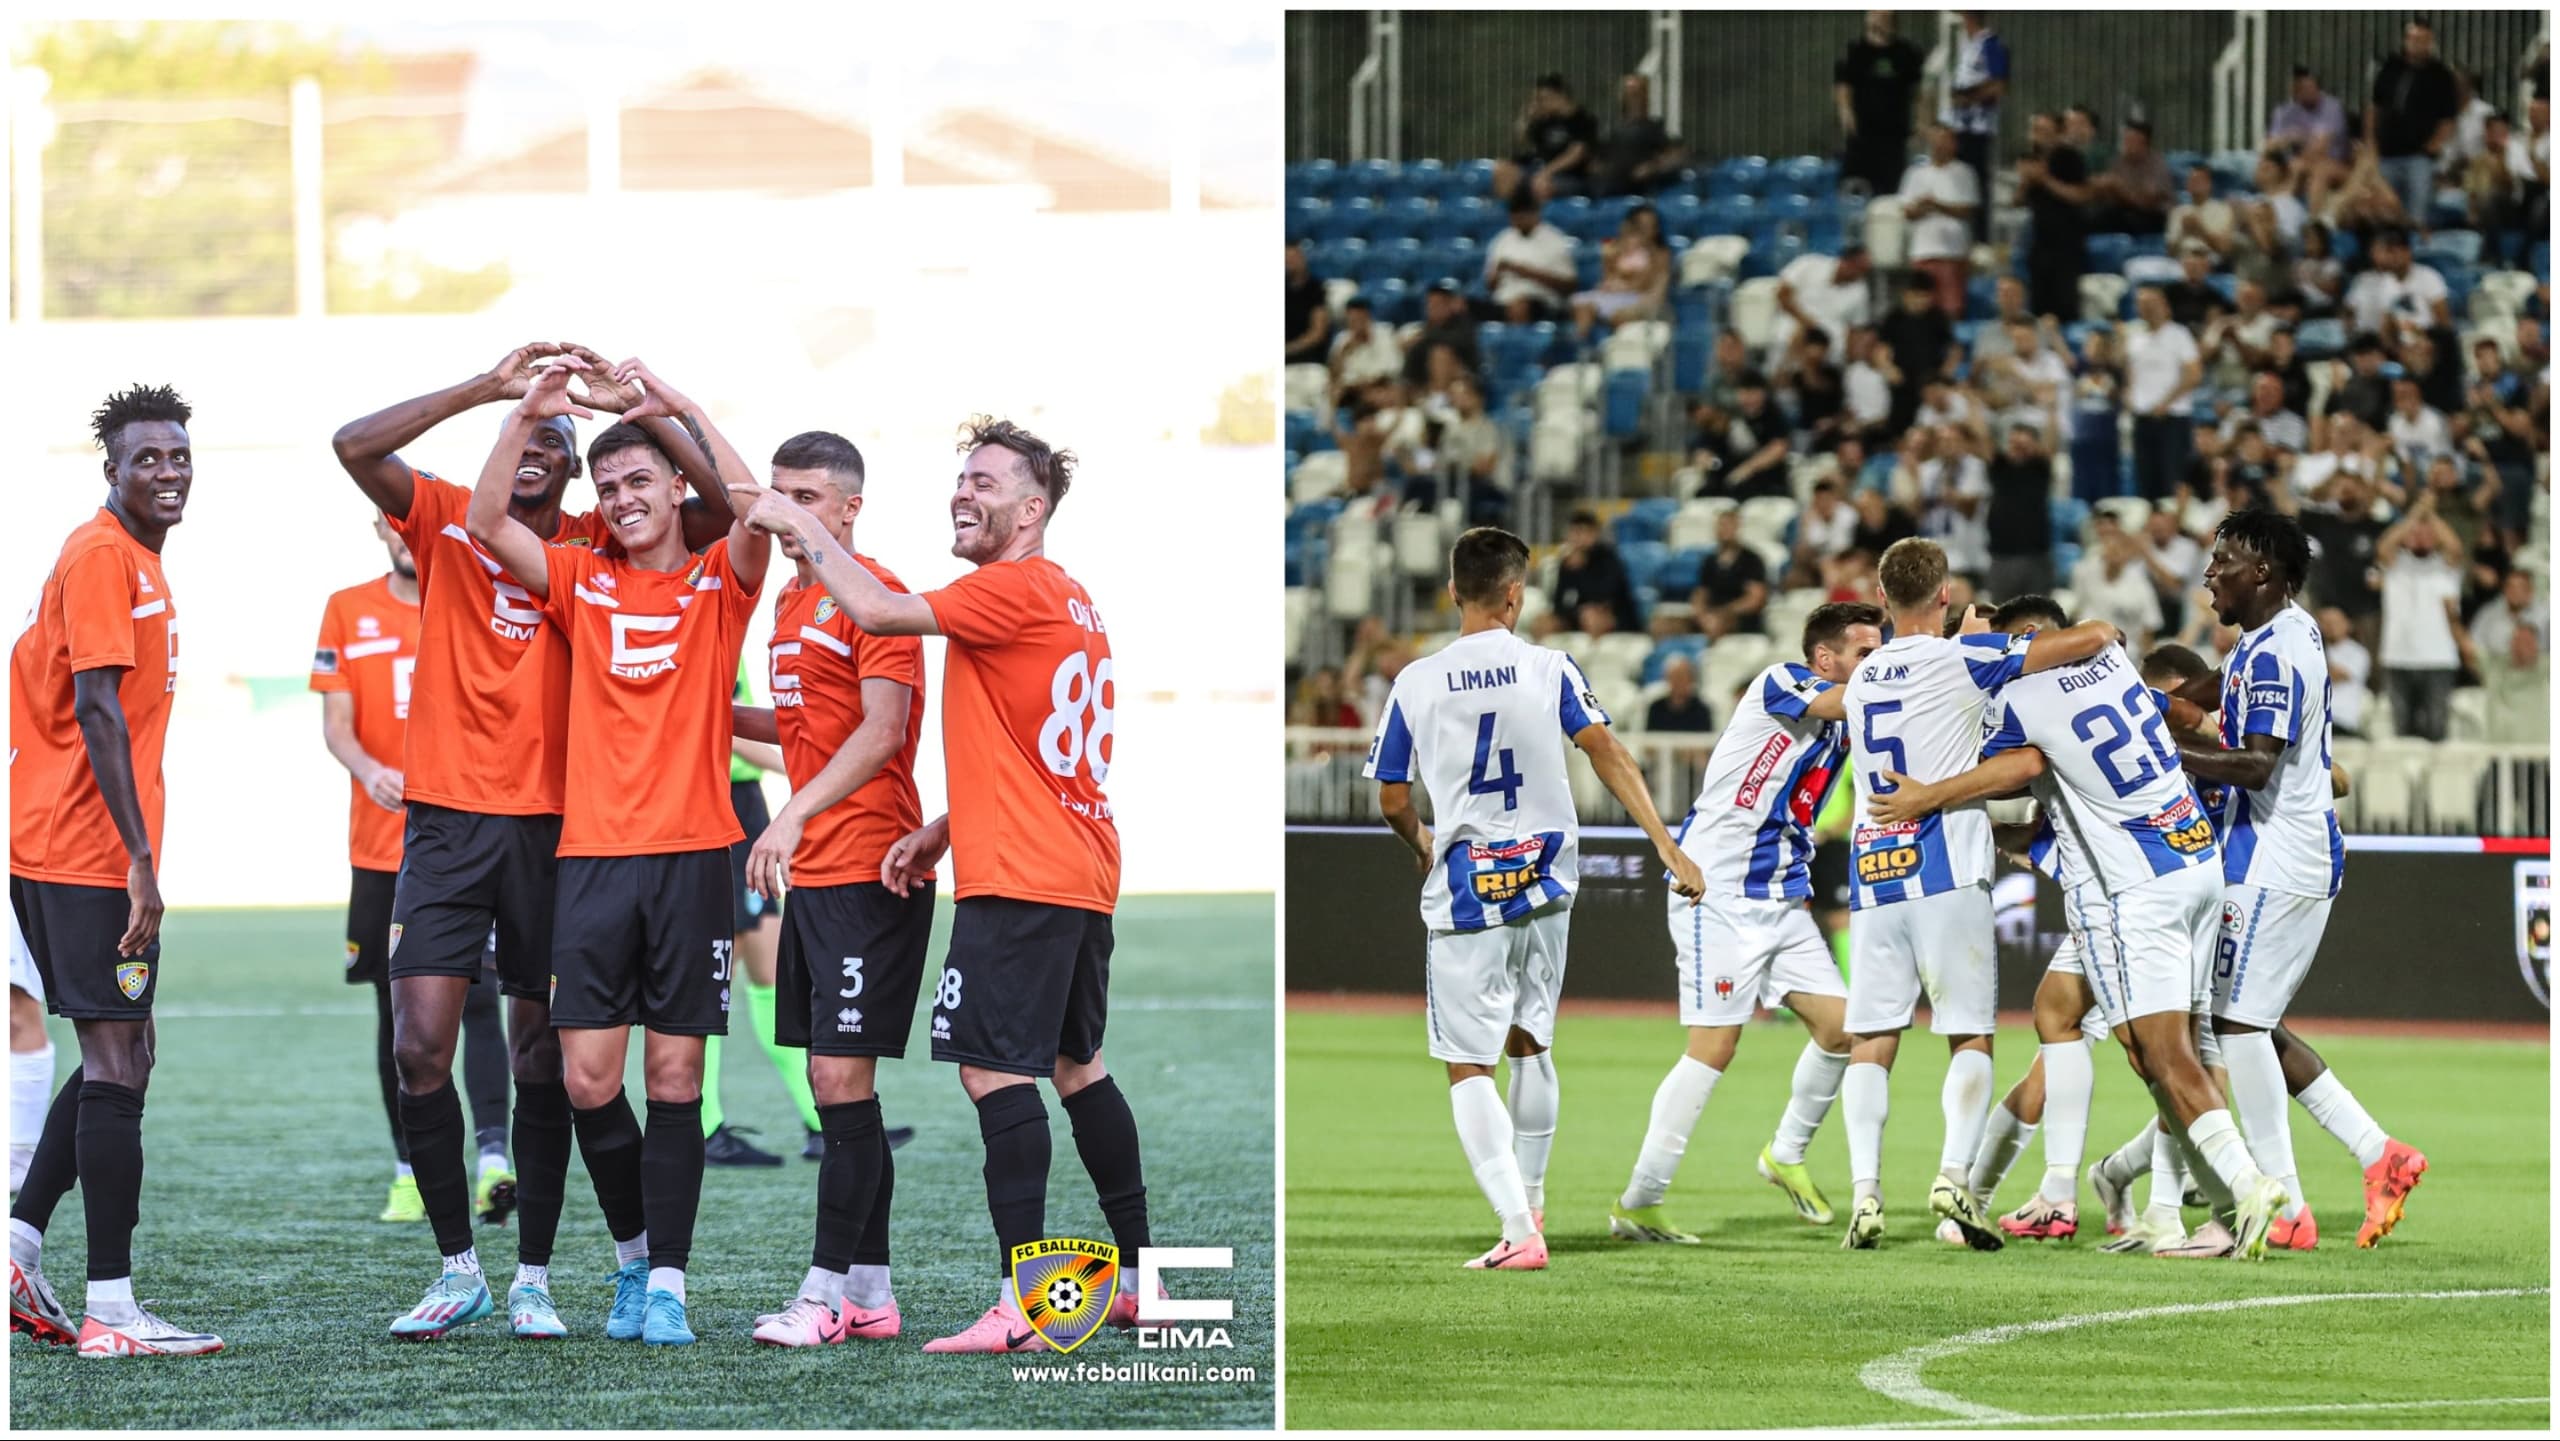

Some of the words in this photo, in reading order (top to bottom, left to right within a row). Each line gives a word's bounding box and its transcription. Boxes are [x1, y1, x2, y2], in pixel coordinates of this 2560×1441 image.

[491, 616, 536, 641] CIM
[1447, 665, 1517, 692] LIMANI
[2250, 690, 2287, 706] JYSK
[1039, 651, 1114, 785] 88
[1863, 699, 1908, 794] 5
[2071, 681, 2182, 799] 22
[1468, 711, 1524, 812] 4
[1749, 735, 1788, 788] ENERVIT
[1859, 847, 1917, 876] RIO
[1865, 868, 1907, 882] mare
[1492, 888, 1517, 900] ma
[712, 939, 733, 981] 37
[840, 957, 864, 999] 3
